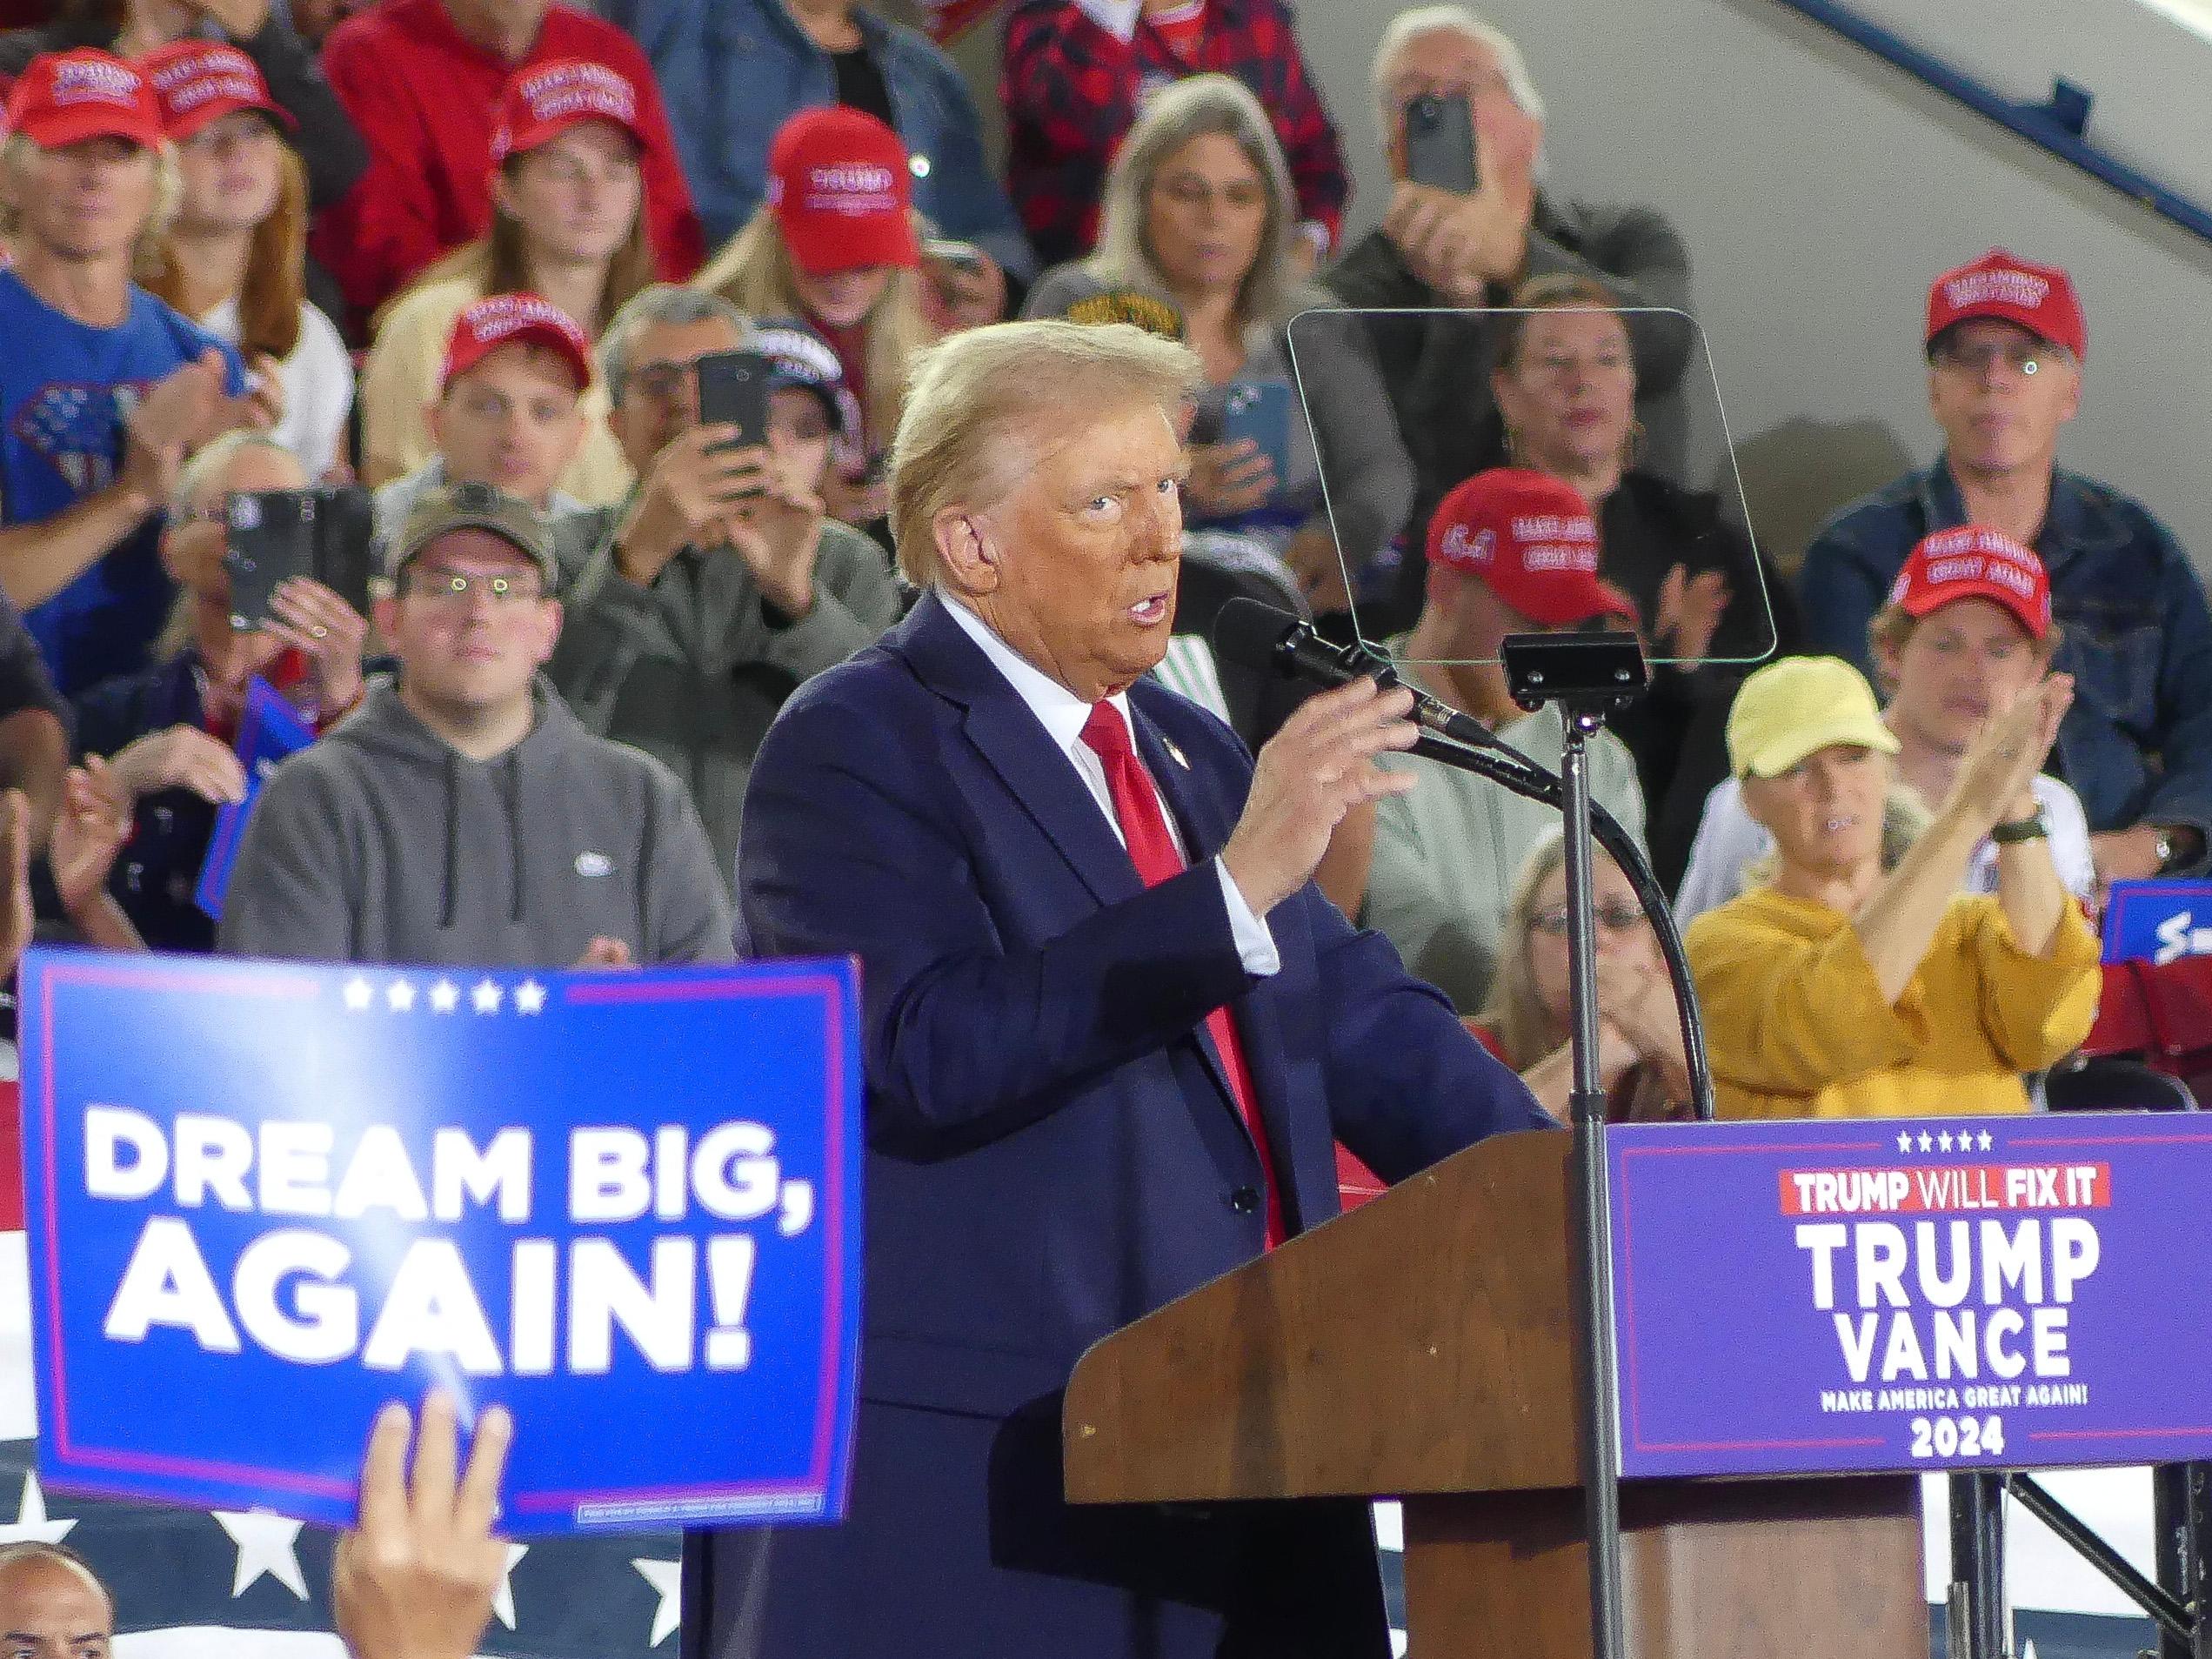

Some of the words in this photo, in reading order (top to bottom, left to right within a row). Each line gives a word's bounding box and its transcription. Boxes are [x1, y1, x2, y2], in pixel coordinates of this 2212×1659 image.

[86, 1107, 531, 1222] DREAM
[570, 1120, 812, 1235] BIG,
[1793, 1171, 1910, 1213] TRUMP
[1915, 1169, 2000, 1210] WILL
[2005, 1167, 2061, 1207] FIX
[2063, 1166, 2097, 1207] IT
[104, 1217, 752, 1374] AGAIN!
[1794, 1217, 2101, 1311] TRUMP
[1832, 1307, 2072, 1382] VANCE
[1820, 1388, 1875, 1413] MAKE
[1876, 1387, 1960, 1411] AMERICA
[1962, 1384, 2022, 1409] GREAT
[2024, 1382, 2088, 1407] AGAIN!
[1908, 1415, 2006, 1460] 2024
